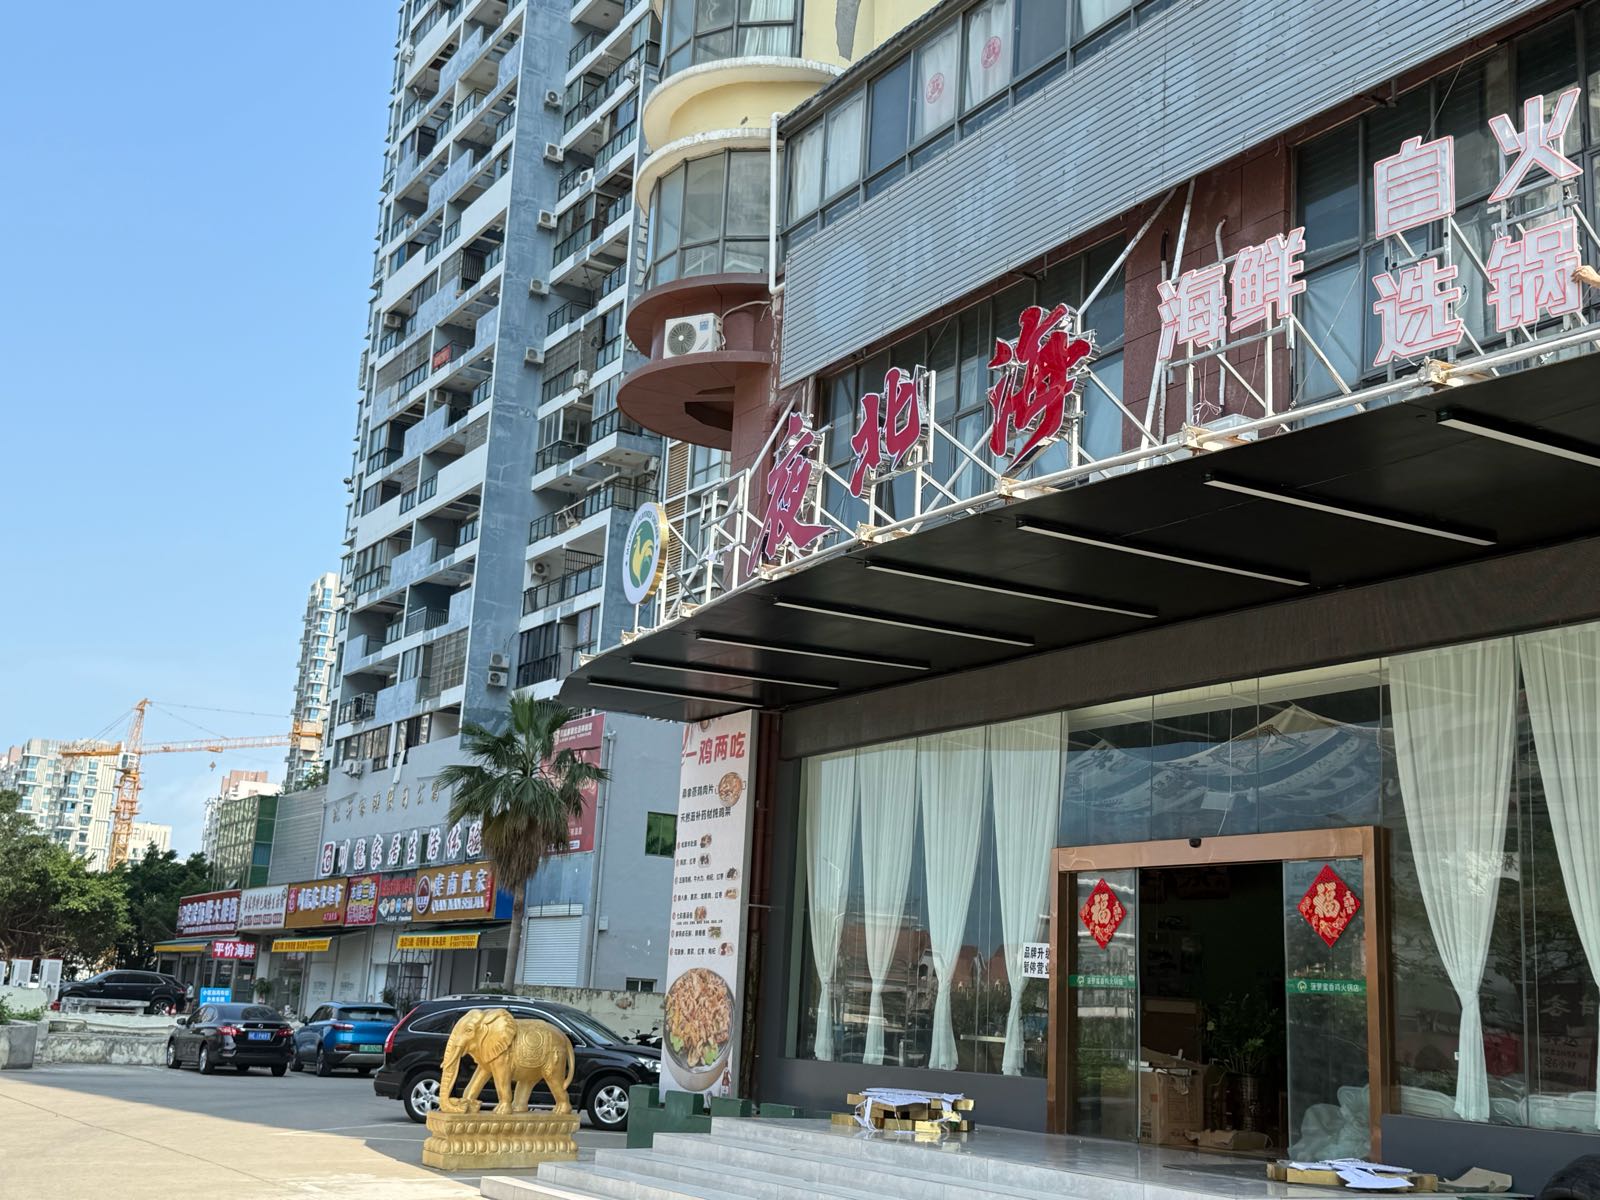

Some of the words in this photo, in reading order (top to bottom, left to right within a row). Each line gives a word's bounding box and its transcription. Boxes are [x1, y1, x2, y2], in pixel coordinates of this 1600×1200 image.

[1157, 227, 1307, 361] 海鲜
[686, 731, 746, 765] 一鸡两吃
[1090, 893, 1111, 924] 福
[1313, 882, 1341, 918] 福
[214, 942, 256, 959] 平价海鲜
